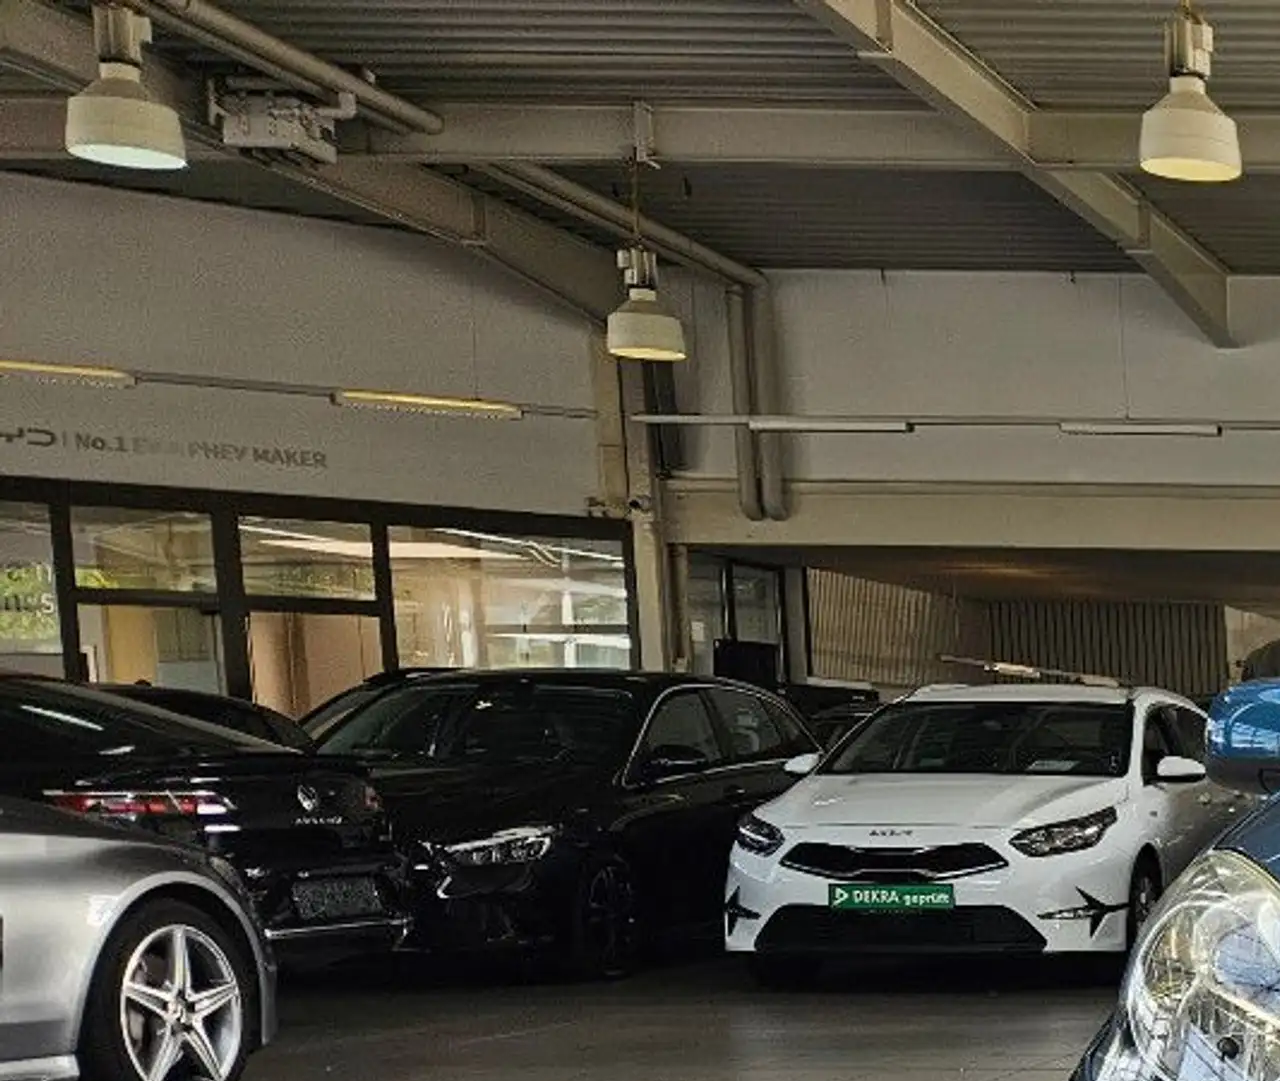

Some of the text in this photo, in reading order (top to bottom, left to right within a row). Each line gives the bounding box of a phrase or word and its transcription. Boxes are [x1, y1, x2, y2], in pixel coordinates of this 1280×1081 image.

[75, 431, 129, 452] No.1
[251, 446, 328, 469] MAKER
[852, 890, 900, 904] DEKRA
